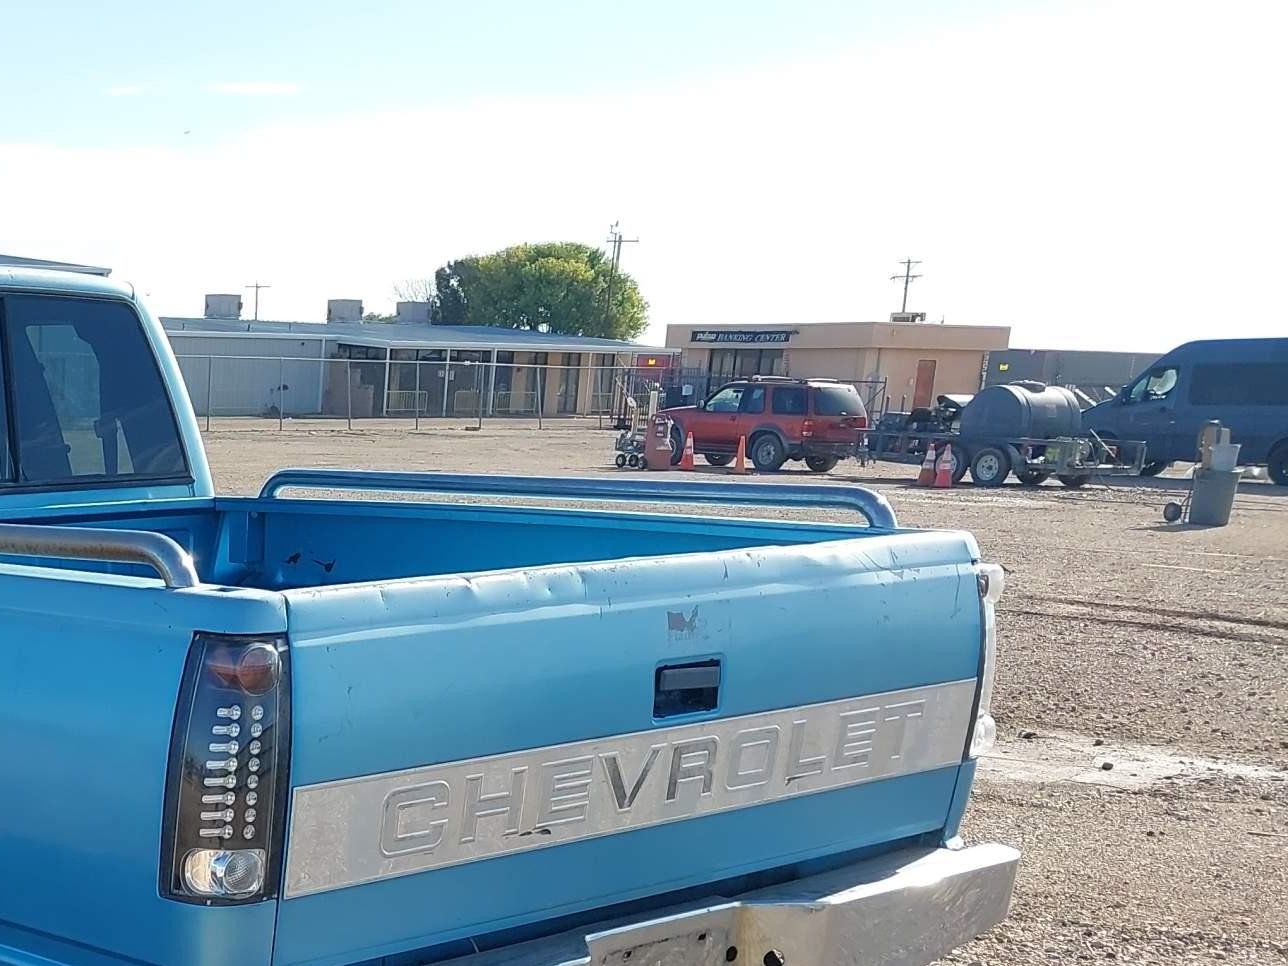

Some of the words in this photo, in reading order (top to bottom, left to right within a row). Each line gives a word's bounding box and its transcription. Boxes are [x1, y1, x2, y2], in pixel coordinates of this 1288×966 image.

[717, 333, 753, 342] BANKING
[755, 333, 786, 342] CENTER
[379, 699, 926, 858] CHEVROLET
